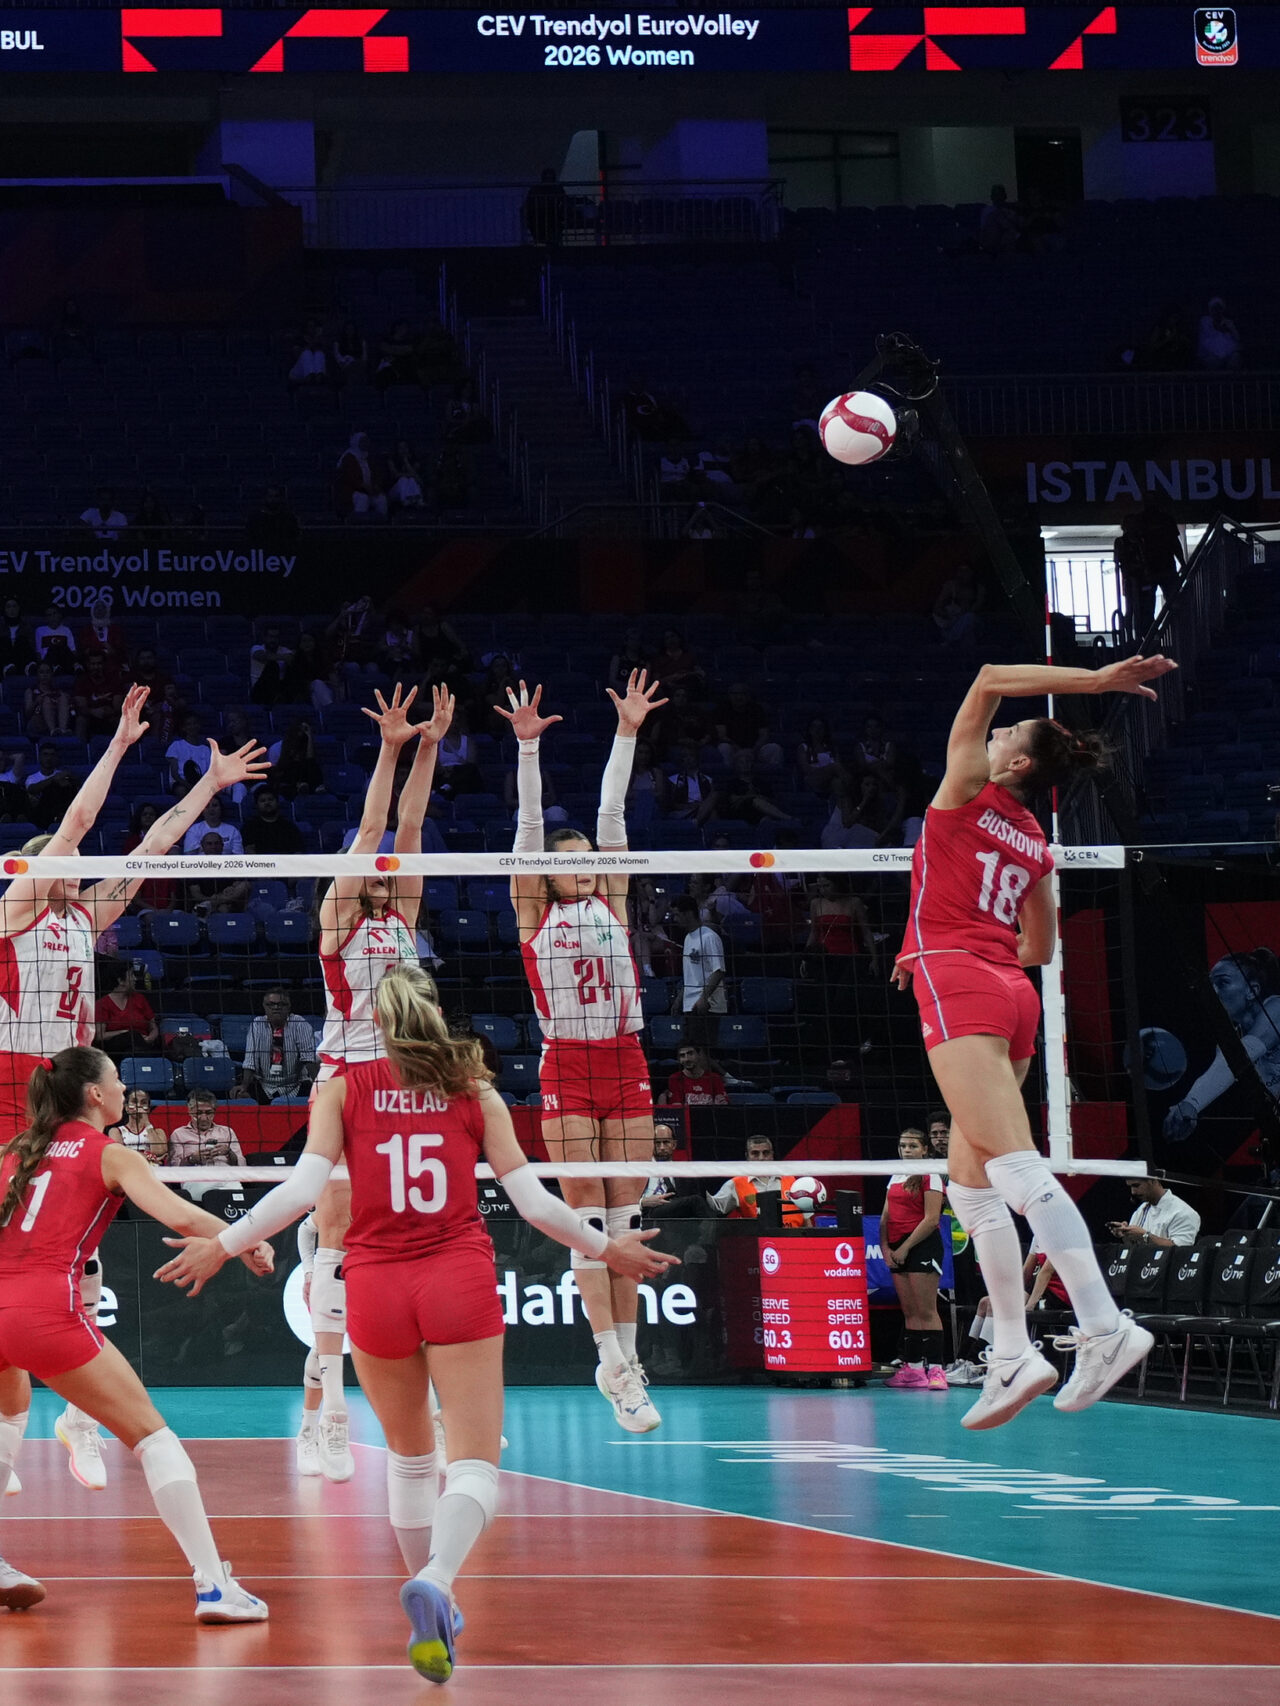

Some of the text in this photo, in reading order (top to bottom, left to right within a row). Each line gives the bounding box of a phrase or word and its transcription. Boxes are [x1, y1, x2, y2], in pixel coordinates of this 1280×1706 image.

[1205, 11, 1224, 19] CEV
[477, 14, 760, 40] CEV Trendyol EuroVolley
[544, 45, 695, 66] 2026 Women
[1128, 107, 1207, 140] 323
[1025, 457, 1280, 504] ISTANBUL
[34, 549, 150, 578] Trendyol
[158, 549, 297, 577] EuroVolley
[51, 586, 223, 608] 2026 Women
[872, 854, 890, 862] CEV
[1078, 851, 1099, 860] CEV
[125, 860, 276, 871] CEV Trendyol EuroVolley 2026 Women
[499, 857, 650, 868] CEV Trendyol EuroVolley 2026 Women
[976, 850, 1030, 925] 18
[362, 947, 396, 956] ORLEN
[573, 956, 611, 1006] 24
[58, 966, 83, 1013] 3
[542, 1094, 559, 1111] 24
[375, 1133, 448, 1214] 15
[491, 1203, 510, 1211] TVF
[823, 1266, 862, 1277] vodafone
[1231, 1269, 1244, 1279] TVF
[762, 1298, 790, 1310] SERVE
[827, 1298, 863, 1310] SERVE
[762, 1312, 791, 1325] SPEED
[827, 1313, 863, 1325] SPEED
[763, 1329, 792, 1348] 60.3
[828, 1330, 865, 1349] 60.3
[767, 1353, 786, 1365] km/h
[837, 1354, 862, 1366] km/h
